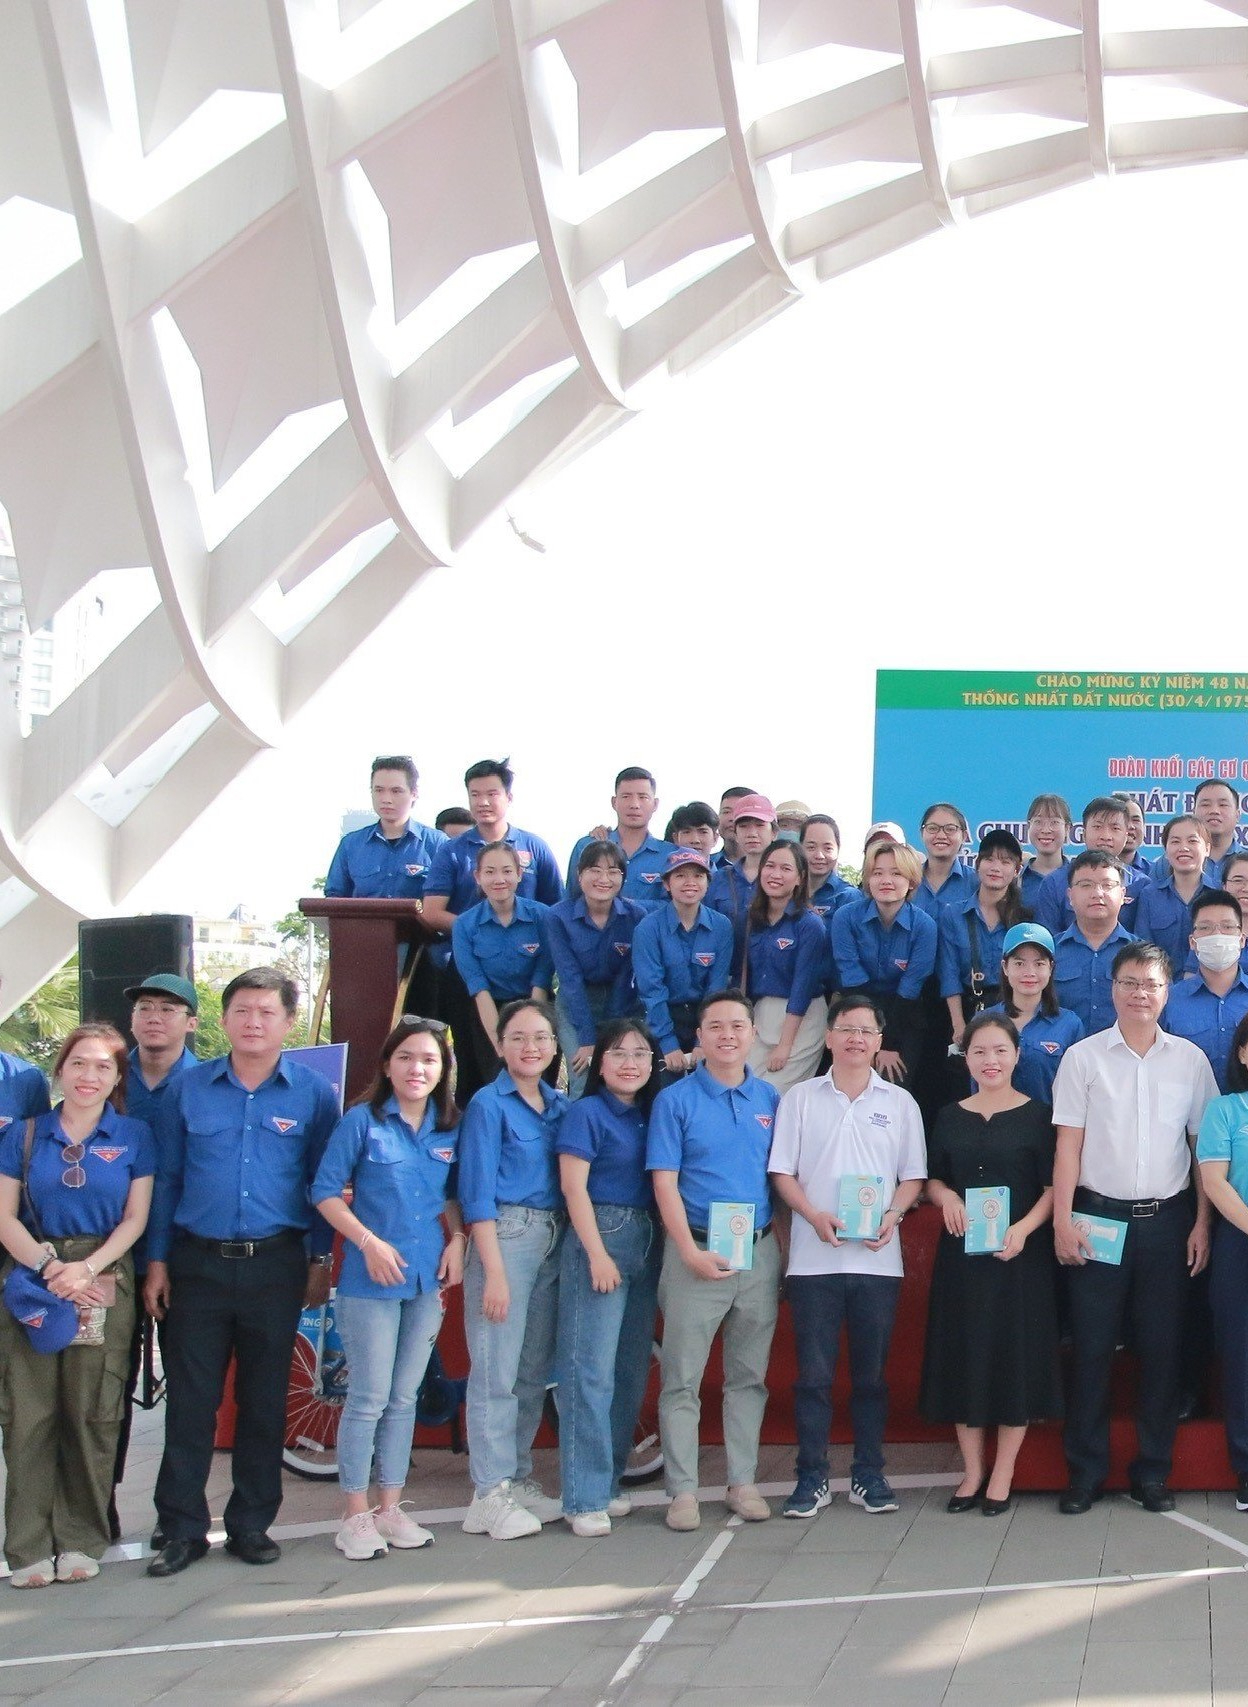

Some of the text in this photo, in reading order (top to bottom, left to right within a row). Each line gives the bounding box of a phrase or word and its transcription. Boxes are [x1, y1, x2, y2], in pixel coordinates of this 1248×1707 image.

[1036, 673, 1082, 688] CHÀO
[1086, 673, 1135, 689] MỪNG
[1165, 675, 1204, 691] NIỆM
[1209, 677, 1229, 690] 48
[962, 688, 1019, 705] THỐNG
[1024, 689, 1068, 706] NHẤT
[1072, 689, 1103, 706] ĐẤT
[1108, 691, 1154, 707] NƯỚC
[1108, 756, 1146, 778] ĐOÀN
[1150, 754, 1182, 779] KHỐI
[1187, 757, 1214, 779] CÁC
[1219, 757, 1239, 779] CƠ
